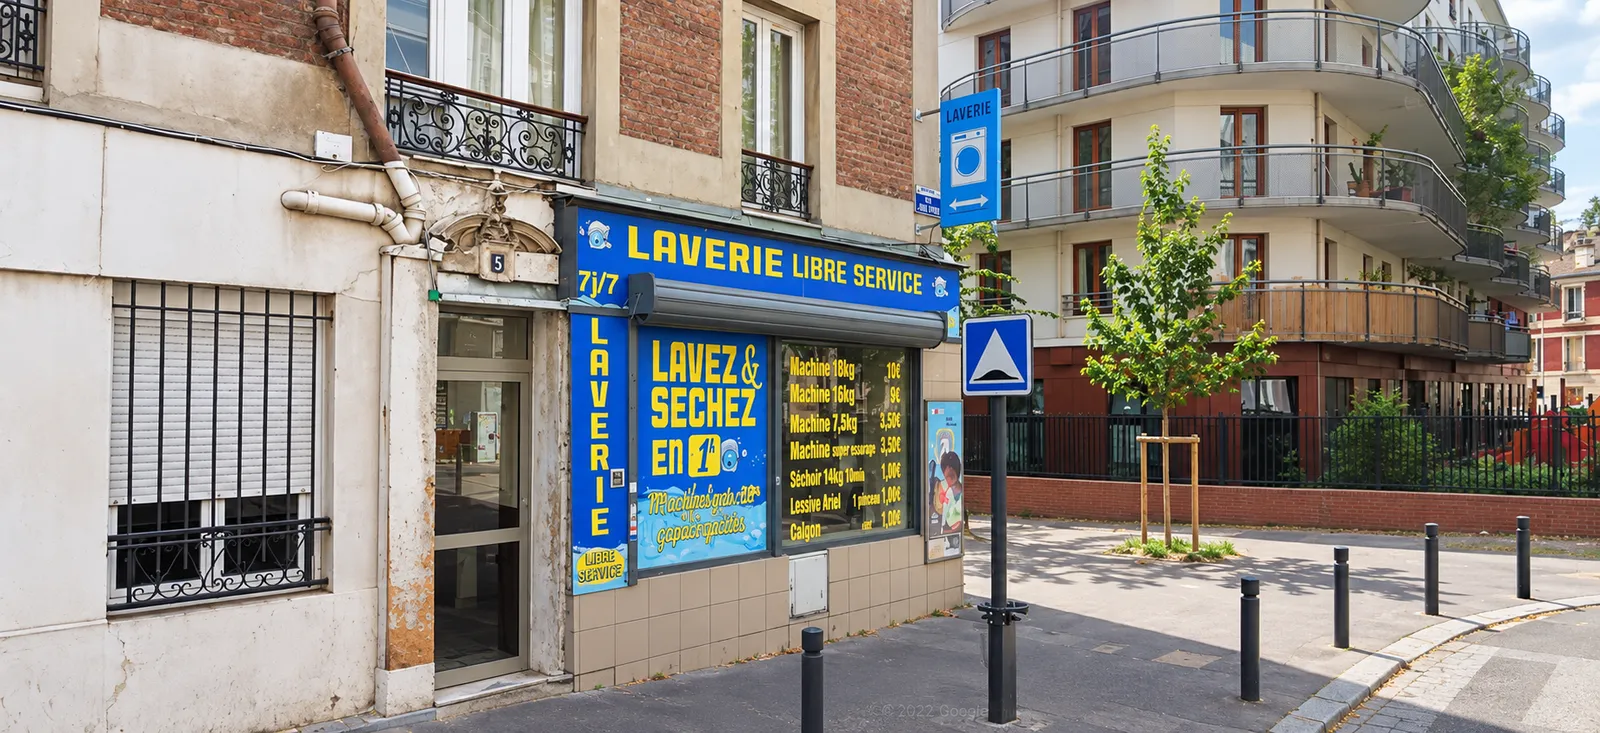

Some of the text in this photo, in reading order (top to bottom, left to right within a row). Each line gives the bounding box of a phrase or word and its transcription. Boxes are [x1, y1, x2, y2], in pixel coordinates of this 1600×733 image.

[946, 100, 991, 124] LAVERIE
[494, 256, 503, 271] 5
[628, 225, 923, 295] LAVERIE LIBRE SERVICE
[578, 270, 619, 298] 7j/7
[652, 339, 763, 390] LAVEZ &
[790, 356, 901, 381] Machine 18kg 10€
[790, 383, 901, 406] Machine 16kg 9€
[651, 386, 757, 429] SECHEZ
[590, 317, 609, 537] LAVERIE
[790, 412, 901, 435] Machine 7,5kg 3,50€
[790, 440, 831, 460] Machine
[880, 436, 901, 457] 3,50€
[790, 469, 822, 488] Séchoir
[823, 467, 844, 487] 14kg
[881, 462, 901, 482] 1,00€
[790, 495, 821, 515] Lessive
[822, 492, 841, 511] Ariel
[881, 485, 901, 506] 1,00€
[790, 521, 821, 543] Calgon
[881, 509, 901, 530] 1,00€
[585, 550, 616, 566] LIBRE
[578, 564, 622, 583] SERVICE
